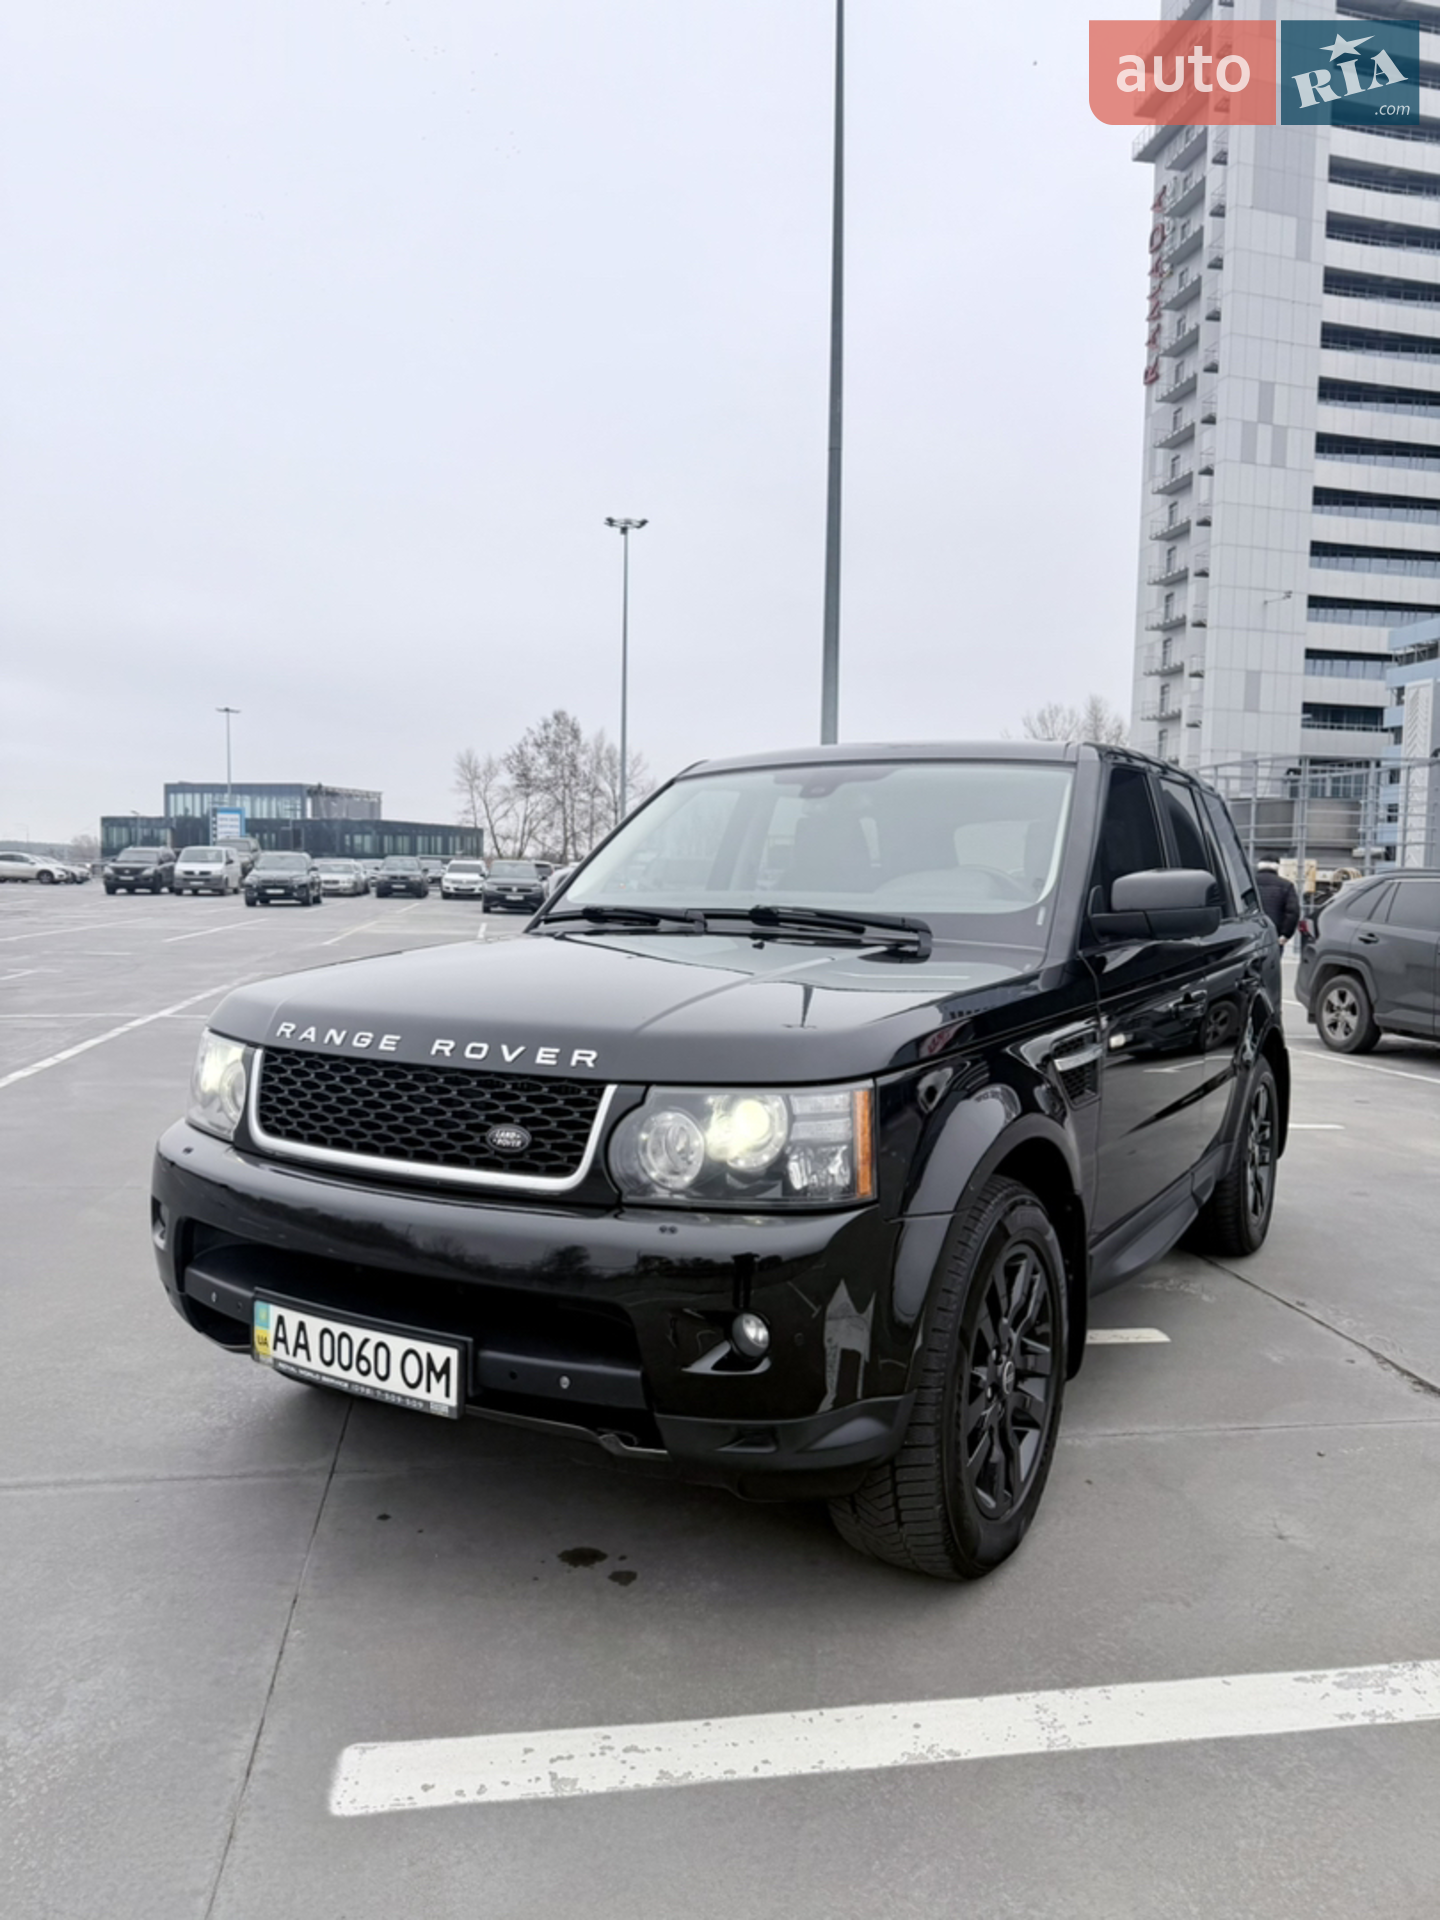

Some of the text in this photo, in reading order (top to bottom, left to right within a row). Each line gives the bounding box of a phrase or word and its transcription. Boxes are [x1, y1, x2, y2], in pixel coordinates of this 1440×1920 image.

[276, 1022, 598, 1069] RANGE ROVER
[256, 1334, 269, 1348] UA
[273, 1314, 451, 1399] AA 0060 OM
